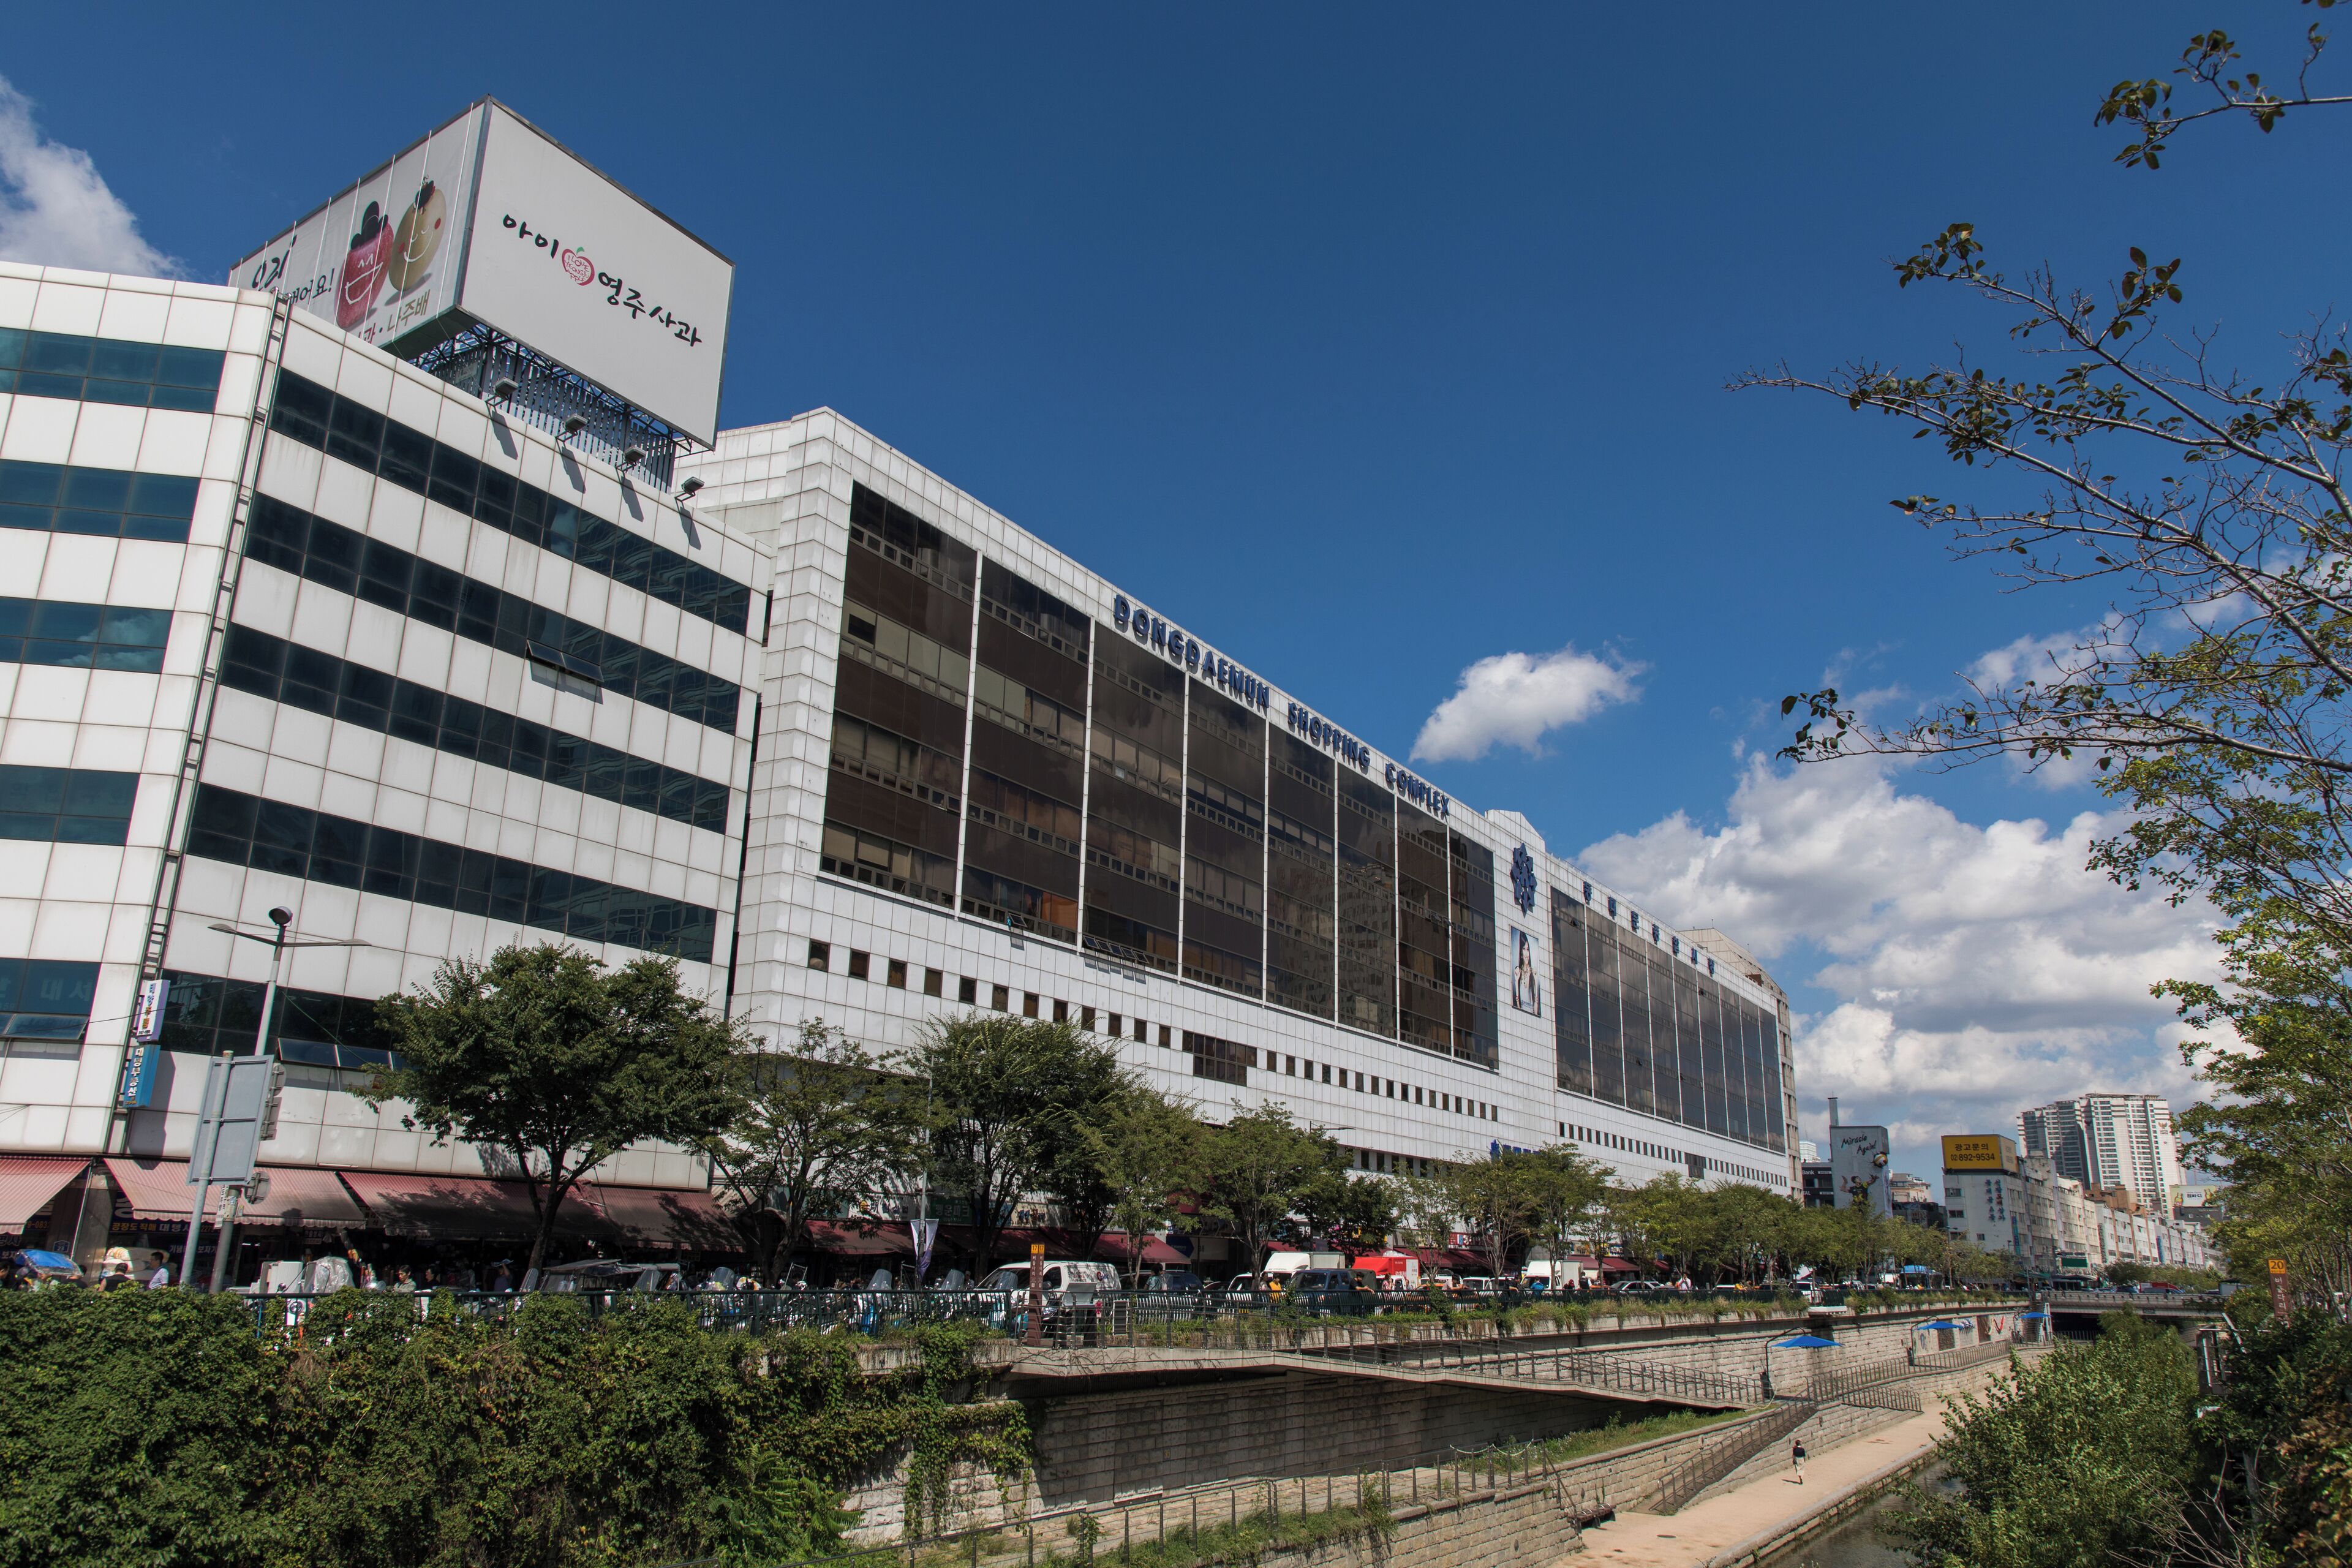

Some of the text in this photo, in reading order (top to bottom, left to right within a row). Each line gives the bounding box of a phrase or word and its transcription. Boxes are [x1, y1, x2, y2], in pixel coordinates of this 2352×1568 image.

[503, 214, 559, 258] 아이
[571, 255, 589, 272] LOVE
[387, 288, 431, 331] 나주배
[1114, 594, 1450, 816] DONGDAEMUN SHOPPING COMPLEX
[127, 1047, 145, 1096] 대명부동산
[1841, 1134, 1867, 1148] Miracle
[1856, 1140, 1877, 1155] Again!
[2271, 1261, 2284, 1270] 20
[2275, 1277, 2286, 1310] 버들다리
